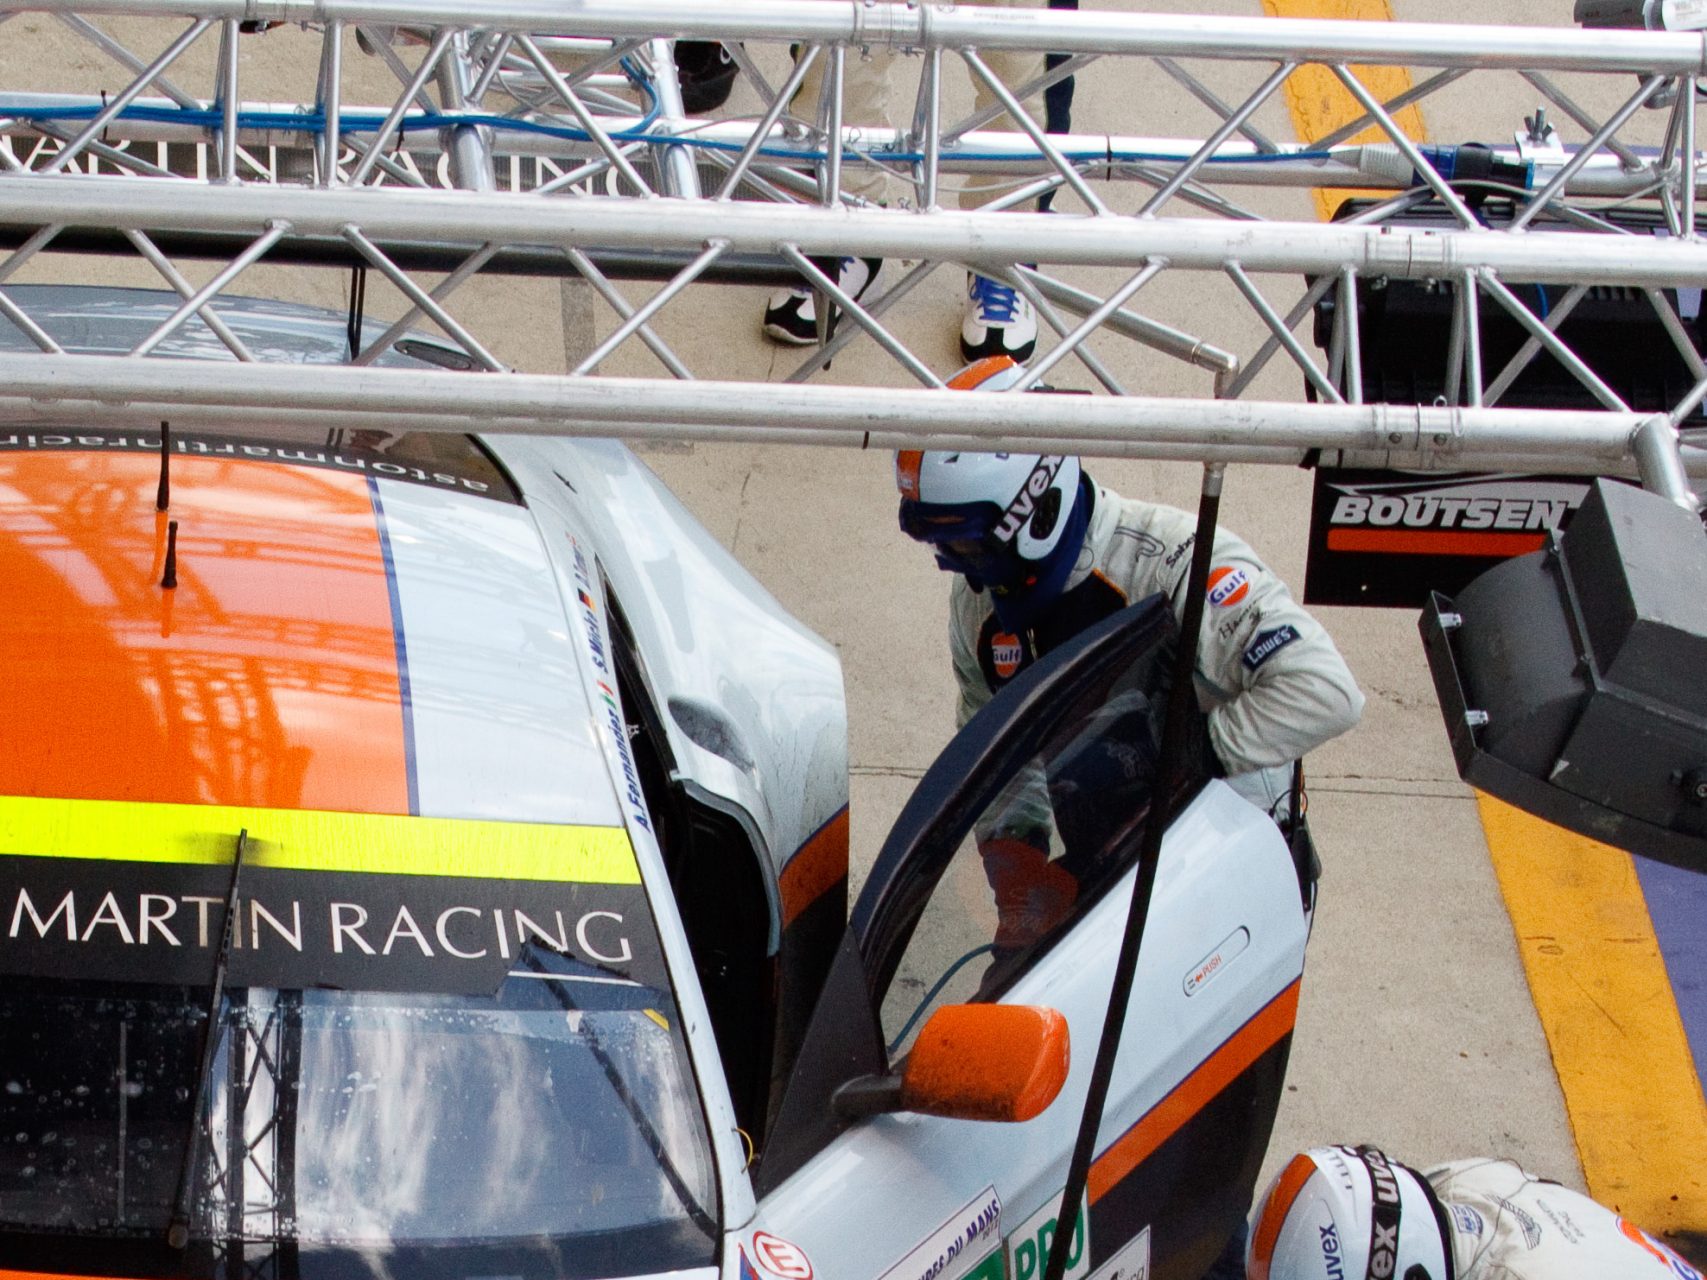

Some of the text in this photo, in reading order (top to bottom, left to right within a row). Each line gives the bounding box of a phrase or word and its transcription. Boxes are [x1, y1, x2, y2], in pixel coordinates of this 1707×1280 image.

[0, 134, 277, 185] ARTIN
[1209, 570, 1246, 605] Gulf
[9, 888, 633, 963] MARTIN RACING
